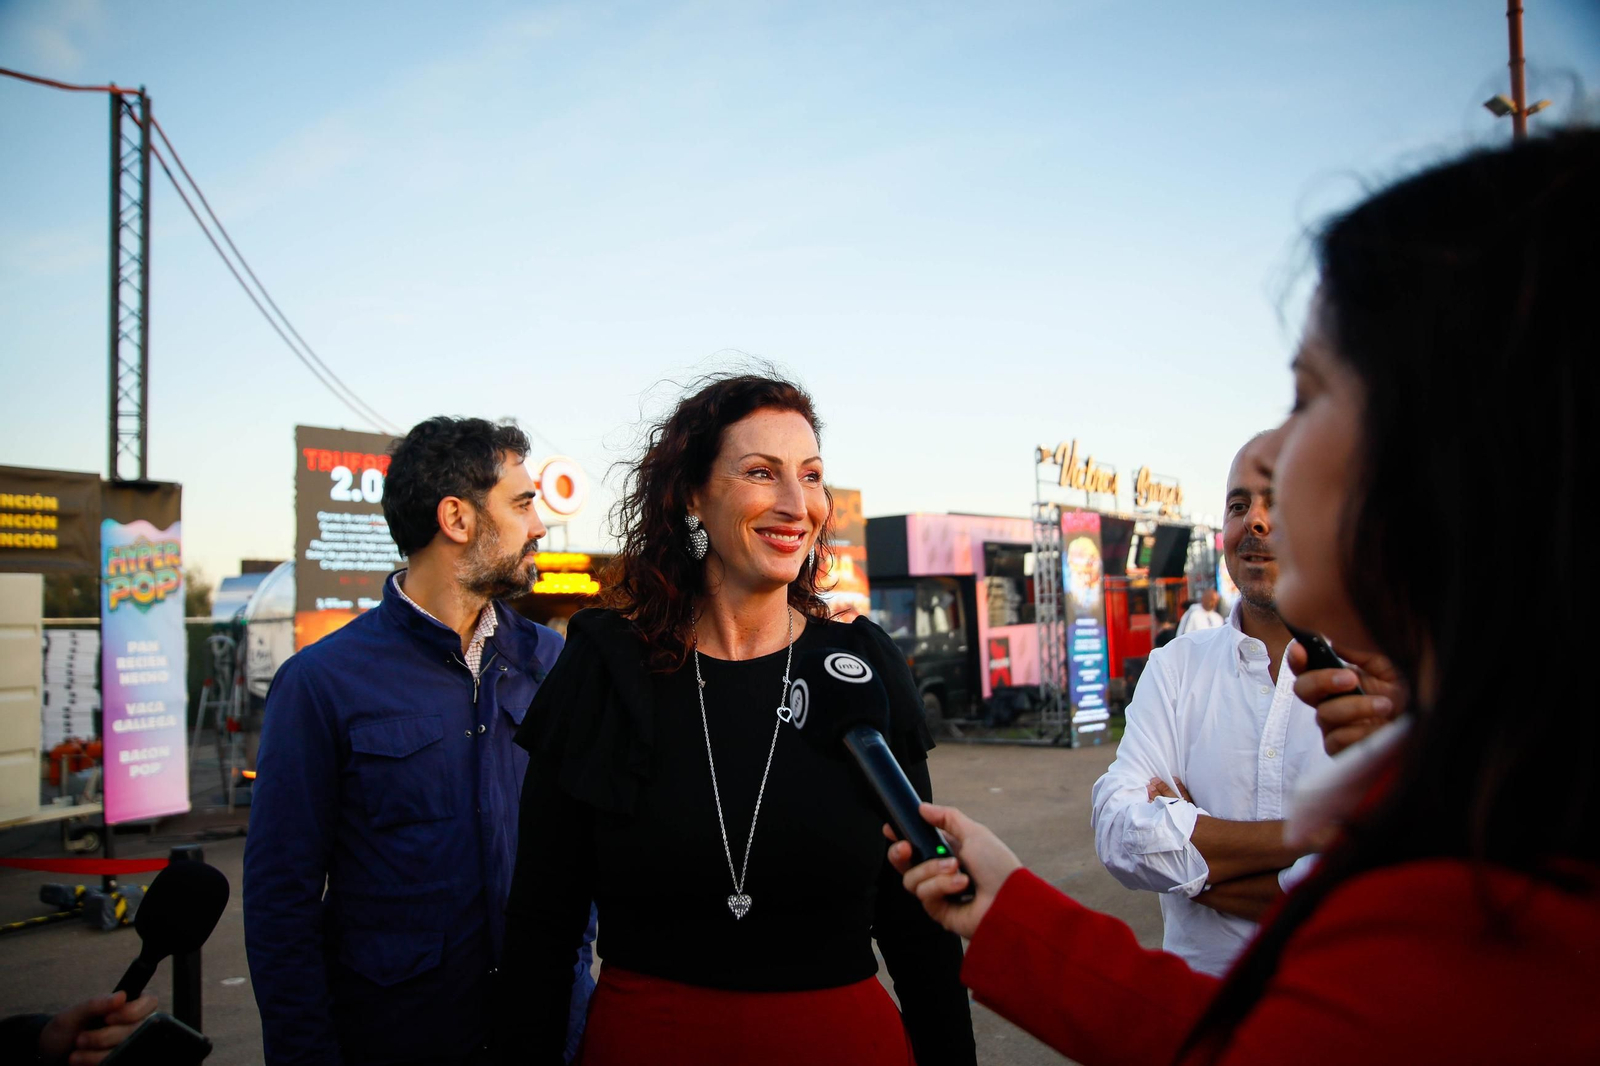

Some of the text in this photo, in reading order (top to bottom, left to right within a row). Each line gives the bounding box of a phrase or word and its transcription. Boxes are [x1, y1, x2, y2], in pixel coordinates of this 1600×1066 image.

[330, 465, 383, 503] 2.0
[107, 541, 181, 577] HYPER
[106, 569, 182, 611] POP
[127, 641, 159, 653] PAN
[125, 701, 166, 715] VACA
[112, 715, 177, 733] GALLEGA
[119, 747, 170, 763] BACON
[129, 762, 161, 777] POP
